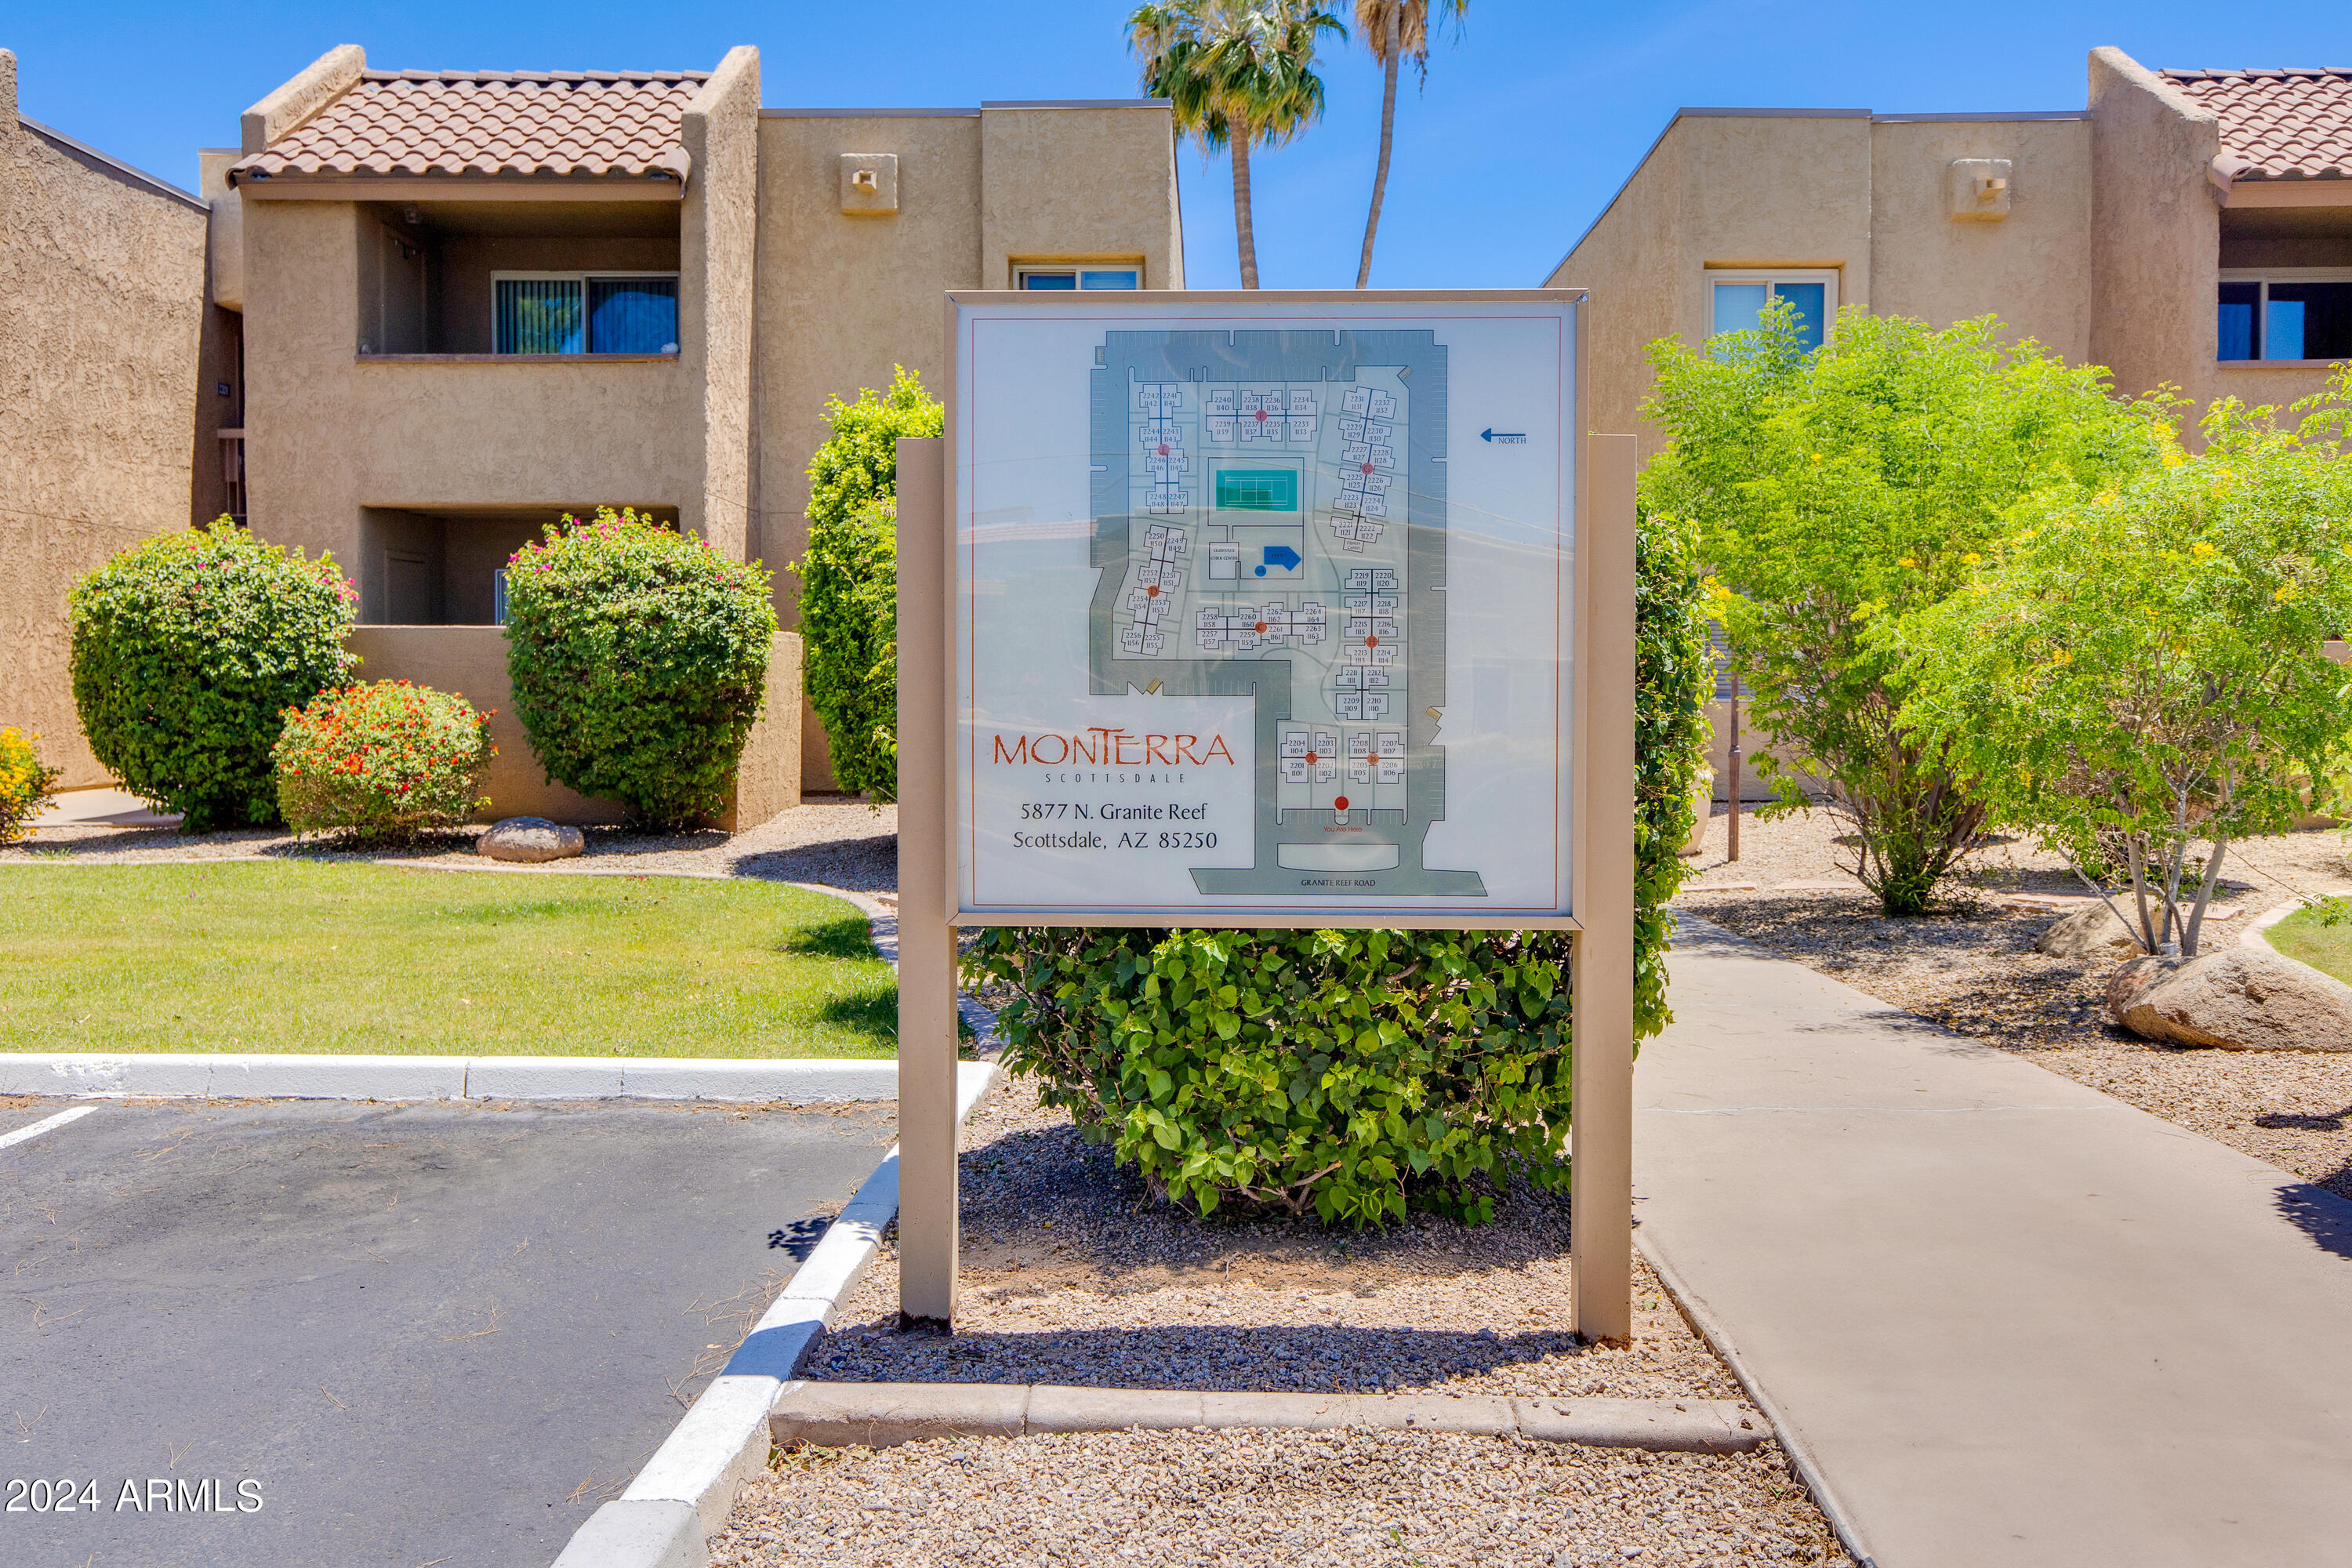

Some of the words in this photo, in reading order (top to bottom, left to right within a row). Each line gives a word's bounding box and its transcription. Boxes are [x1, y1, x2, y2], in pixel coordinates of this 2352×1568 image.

[994, 728, 1235, 765] MONTERRA
[1046, 773, 1185, 783] SCOTTSDALE
[1021, 804, 1067, 819] 5877
[1075, 804, 1093, 819] N.
[1100, 804, 1163, 819] Granite
[1169, 804, 1207, 819] Reef
[1013, 831, 1107, 850] Scottsdale,
[1118, 833, 1149, 848] AZ
[1159, 832, 1218, 848] 85250
